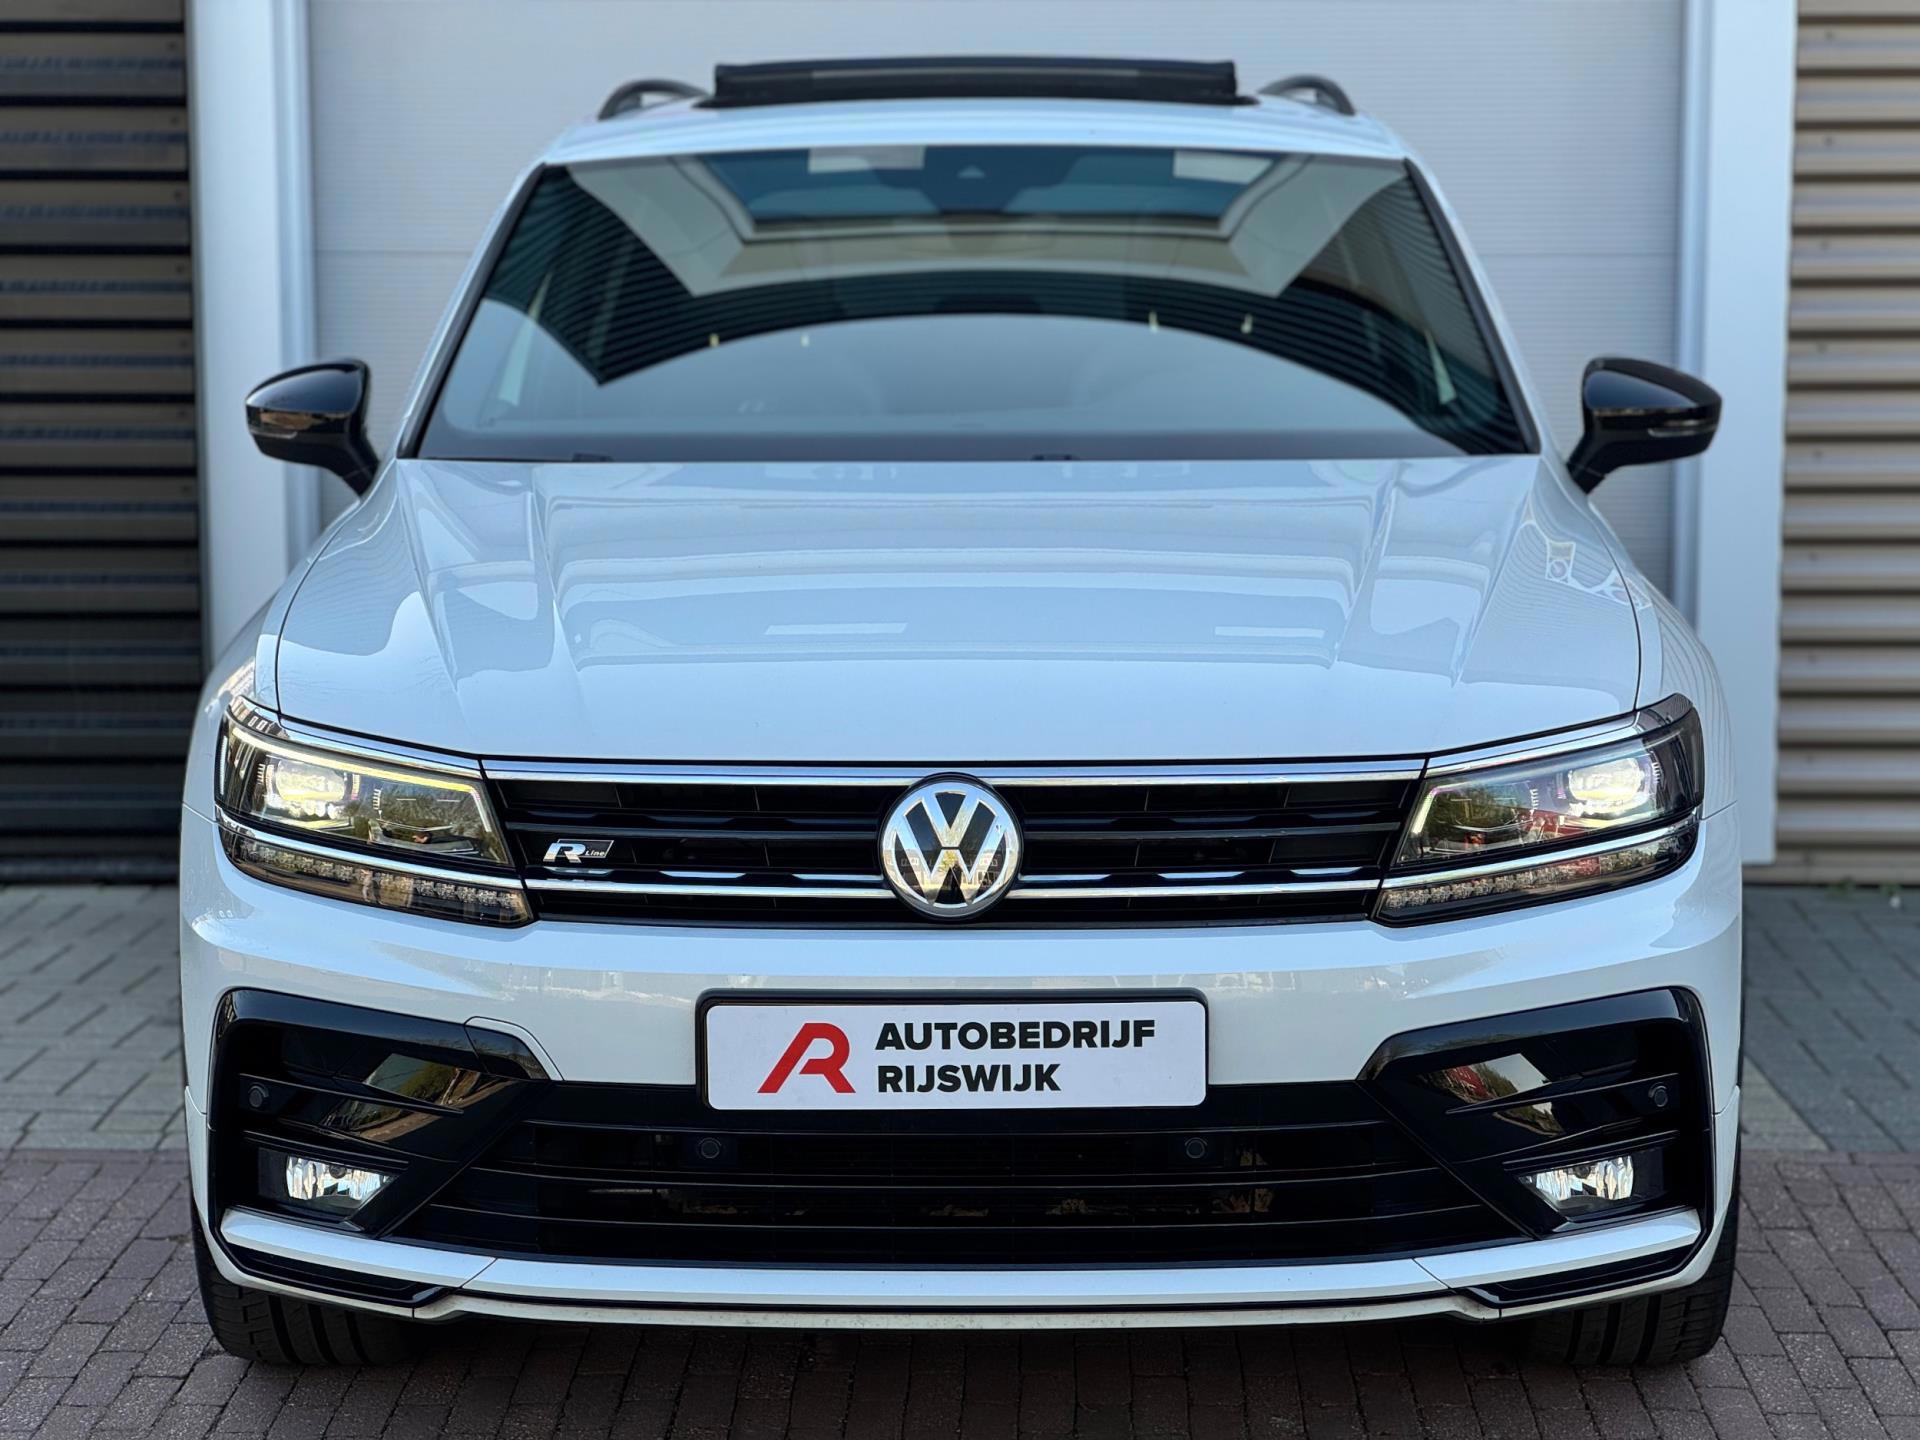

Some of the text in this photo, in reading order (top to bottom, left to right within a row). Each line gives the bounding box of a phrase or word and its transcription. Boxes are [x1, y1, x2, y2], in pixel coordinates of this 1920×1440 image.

[542, 843, 586, 863] R
[874, 1019, 1155, 1051] AUTOBEDRIJF
[877, 1063, 1062, 1093] RIJSWIJK
